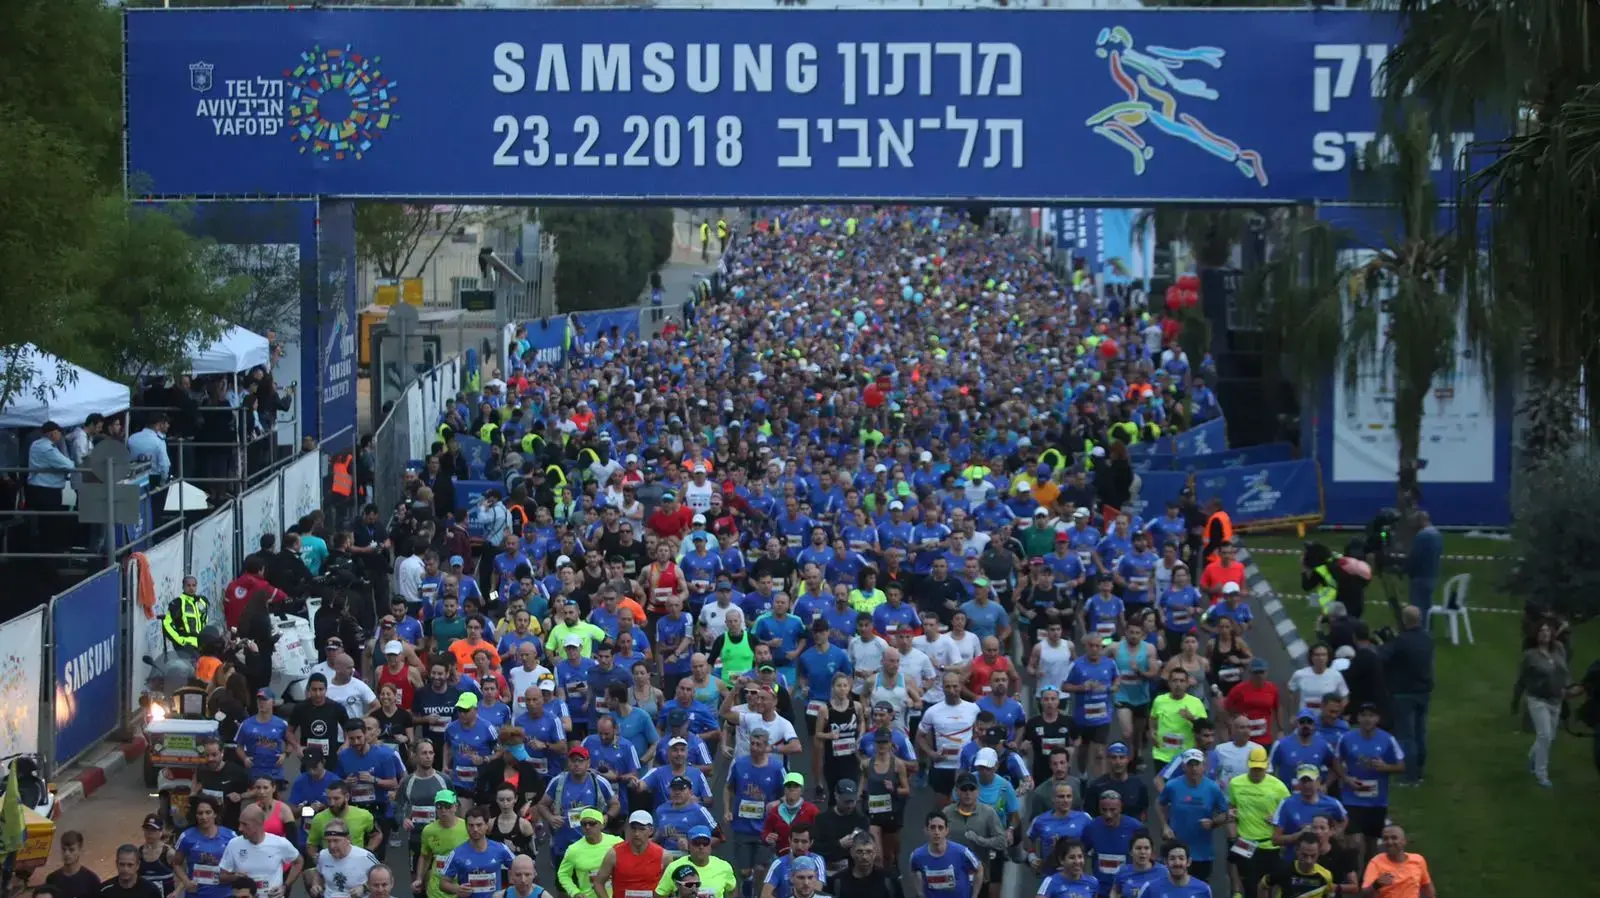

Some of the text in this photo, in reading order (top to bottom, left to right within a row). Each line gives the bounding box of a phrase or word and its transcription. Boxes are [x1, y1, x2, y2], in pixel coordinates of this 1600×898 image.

[493, 42, 818, 93] SAMSUNG
[837, 42, 1022, 105] מרתון
[225, 80, 257, 97] TEL
[257, 76, 283, 97] תל
[196, 100, 237, 116] AVIV
[239, 100, 284, 116] אביב
[212, 118, 257, 135] YAFO
[258, 118, 284, 135] יפו
[493, 115, 743, 167] 23.2.2018
[1312, 132, 1475, 172] STAT
